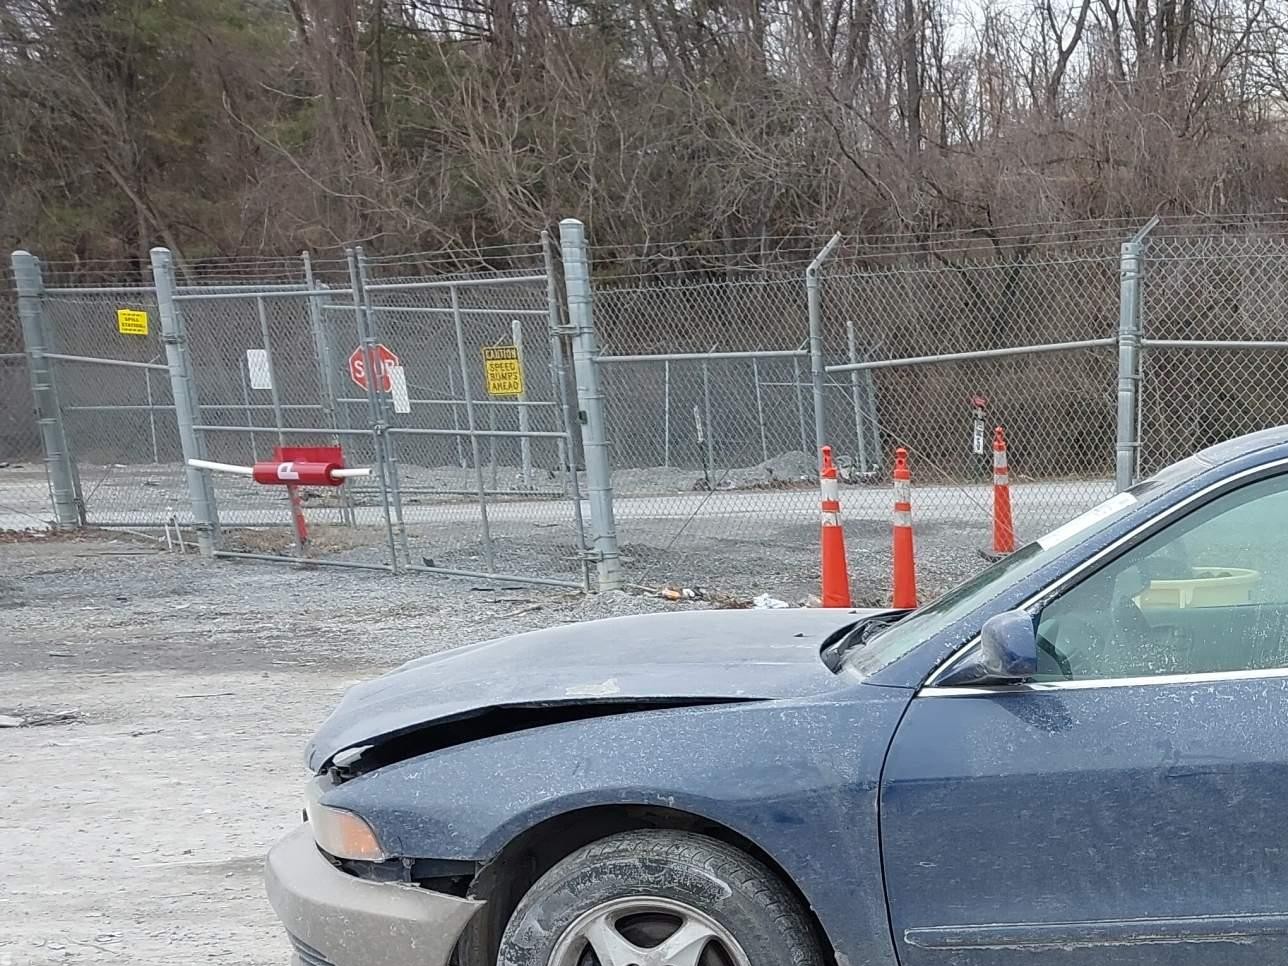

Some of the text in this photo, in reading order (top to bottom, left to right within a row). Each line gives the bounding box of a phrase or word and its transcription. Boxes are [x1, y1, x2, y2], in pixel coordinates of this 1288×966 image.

[485, 349, 516, 359] CAUTION
[490, 362, 516, 372] SPEED
[490, 371, 518, 381] BUMPS
[491, 381, 519, 391] AHEAD
